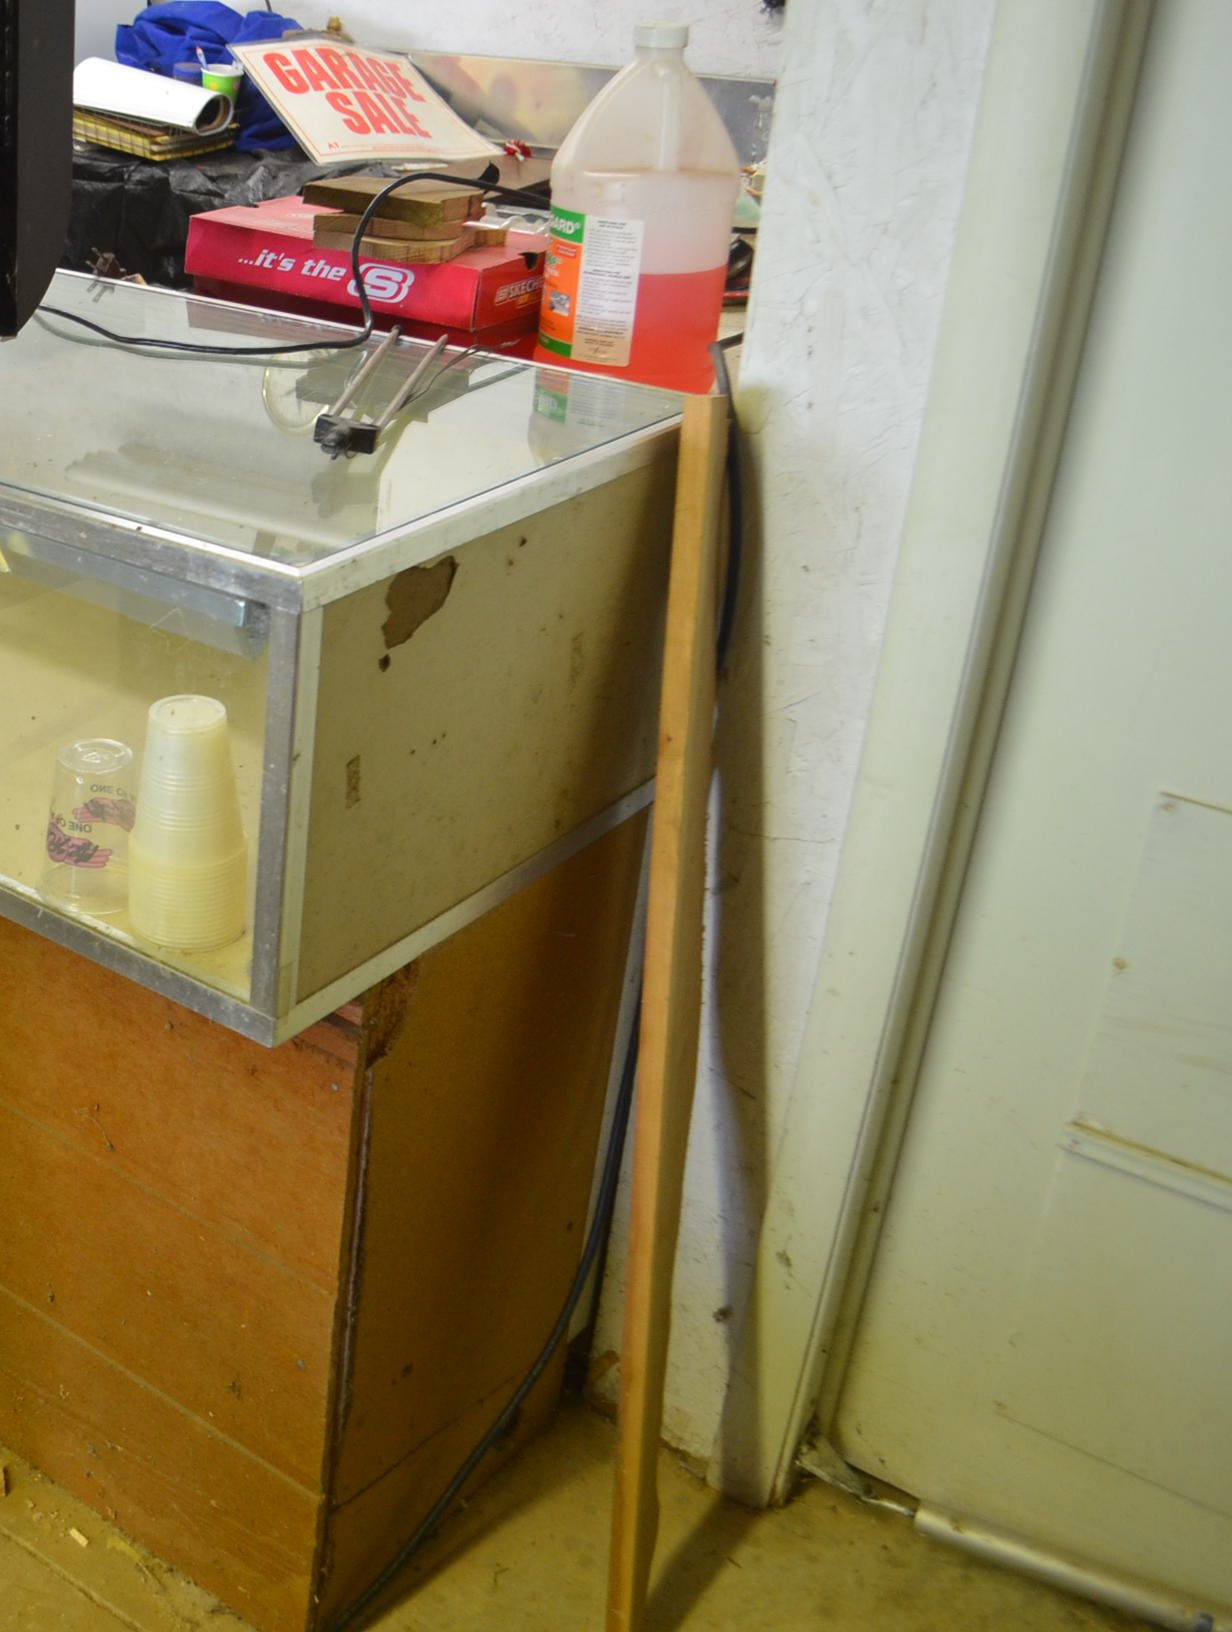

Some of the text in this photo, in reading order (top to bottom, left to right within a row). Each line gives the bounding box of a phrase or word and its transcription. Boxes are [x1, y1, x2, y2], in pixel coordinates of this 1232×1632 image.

[263, 47, 426, 102] GARAGE
[325, 91, 432, 139] SALE
[300, 258, 346, 281] the
